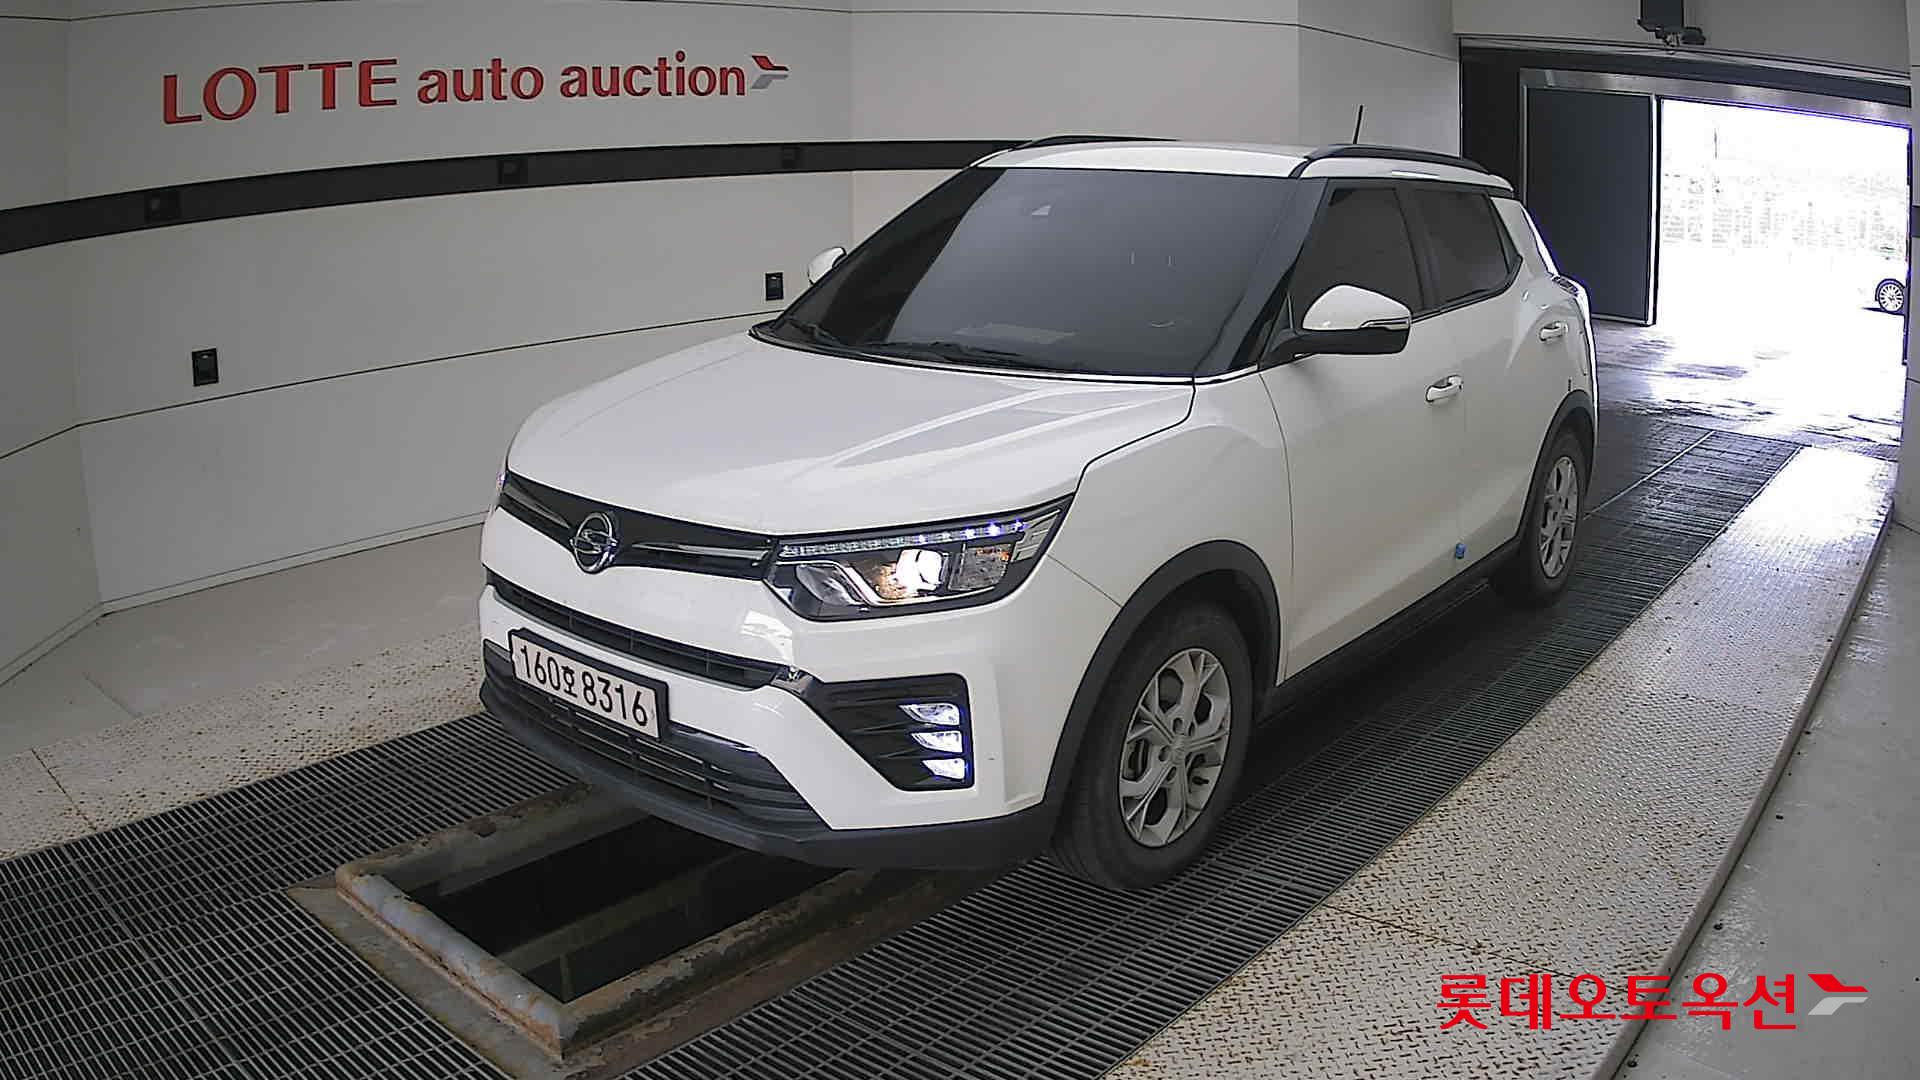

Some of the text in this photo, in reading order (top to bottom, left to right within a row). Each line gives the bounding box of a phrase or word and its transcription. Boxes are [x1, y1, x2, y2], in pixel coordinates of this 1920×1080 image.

[162, 50, 746, 125] LOTTE auto auction
